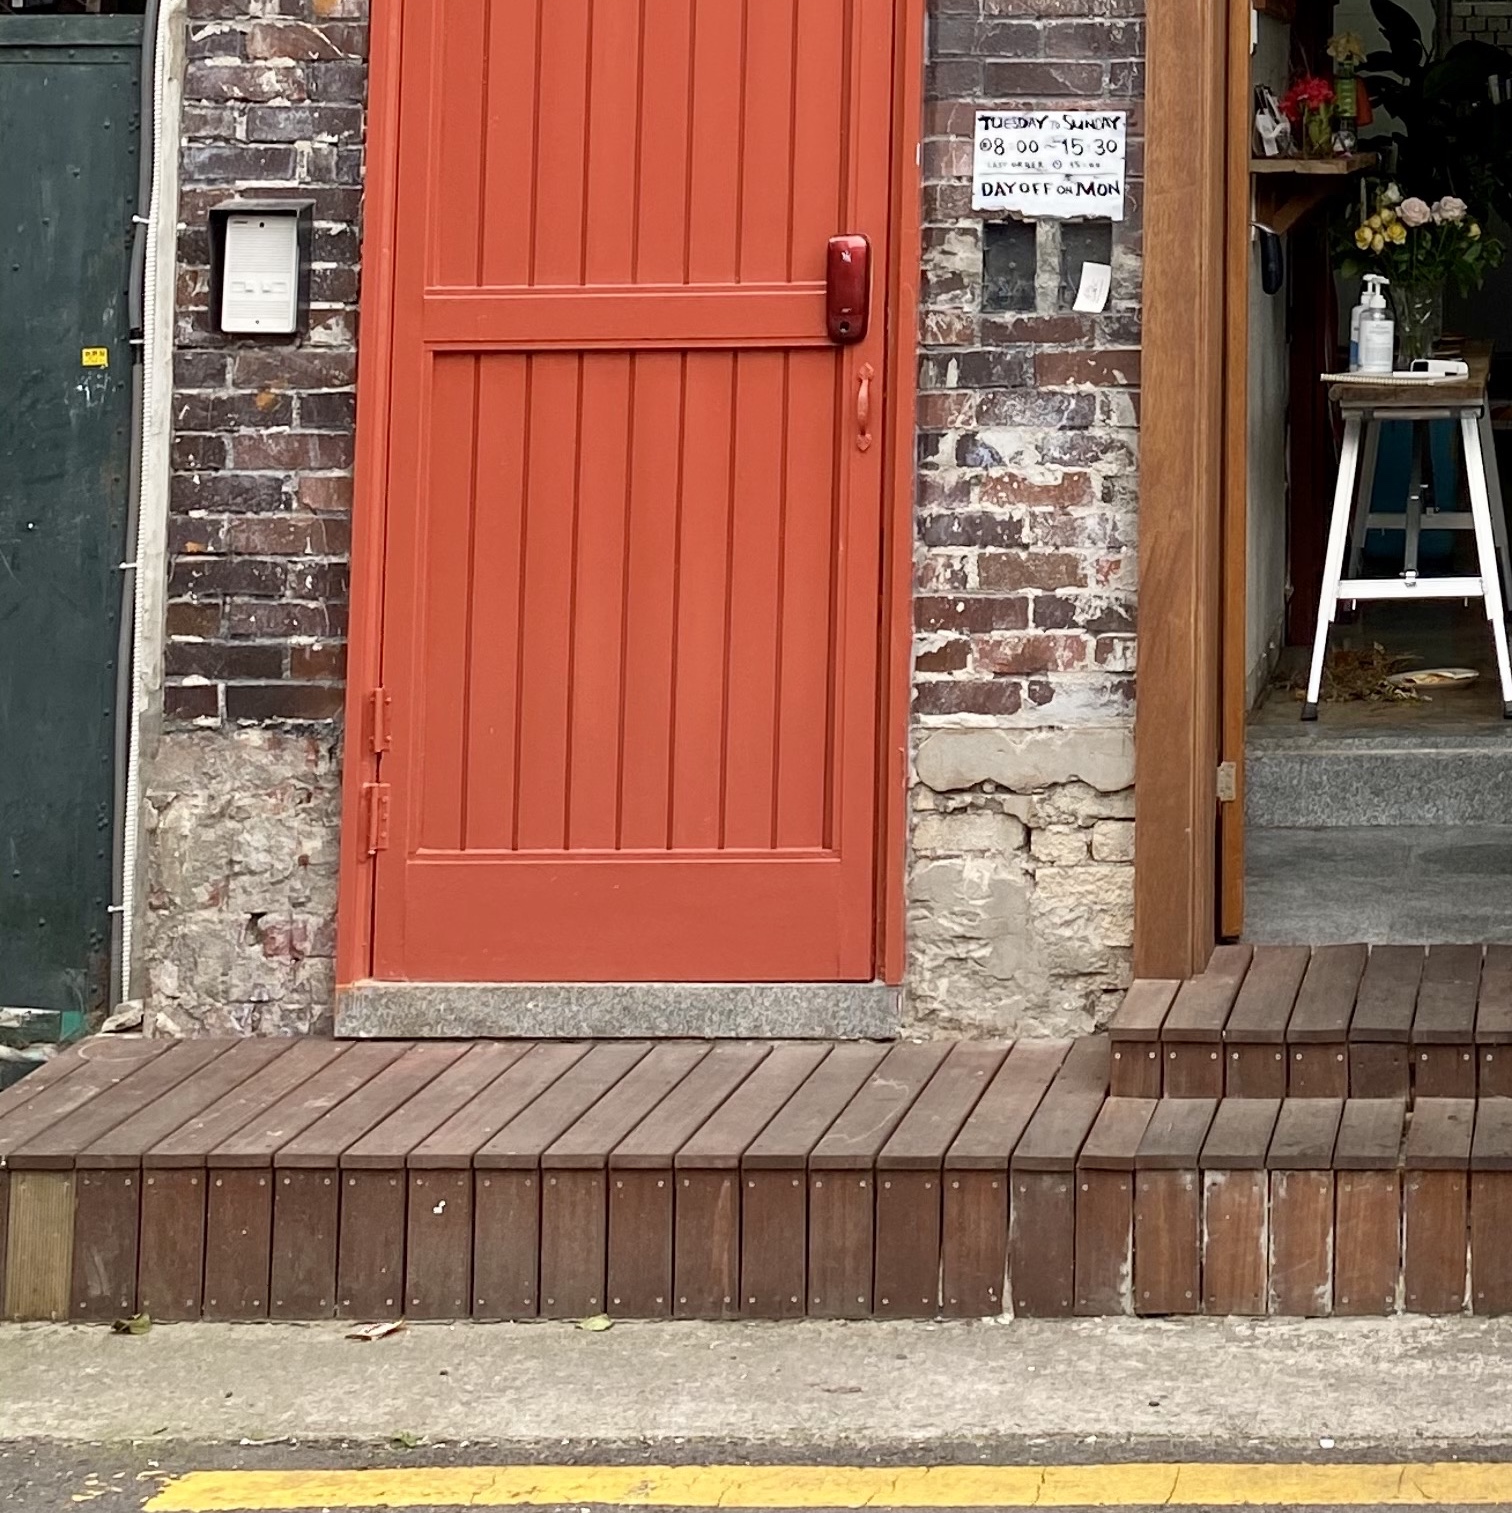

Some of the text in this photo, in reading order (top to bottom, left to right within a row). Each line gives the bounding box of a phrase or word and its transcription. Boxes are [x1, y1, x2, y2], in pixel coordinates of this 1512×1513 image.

[977, 115, 1049, 130] TUESDAY
[1062, 114, 1121, 130] SUNDAY
[981, 181, 1017, 197] DAY
[1019, 182, 1053, 195] OFF
[1075, 180, 1121, 197] MON
